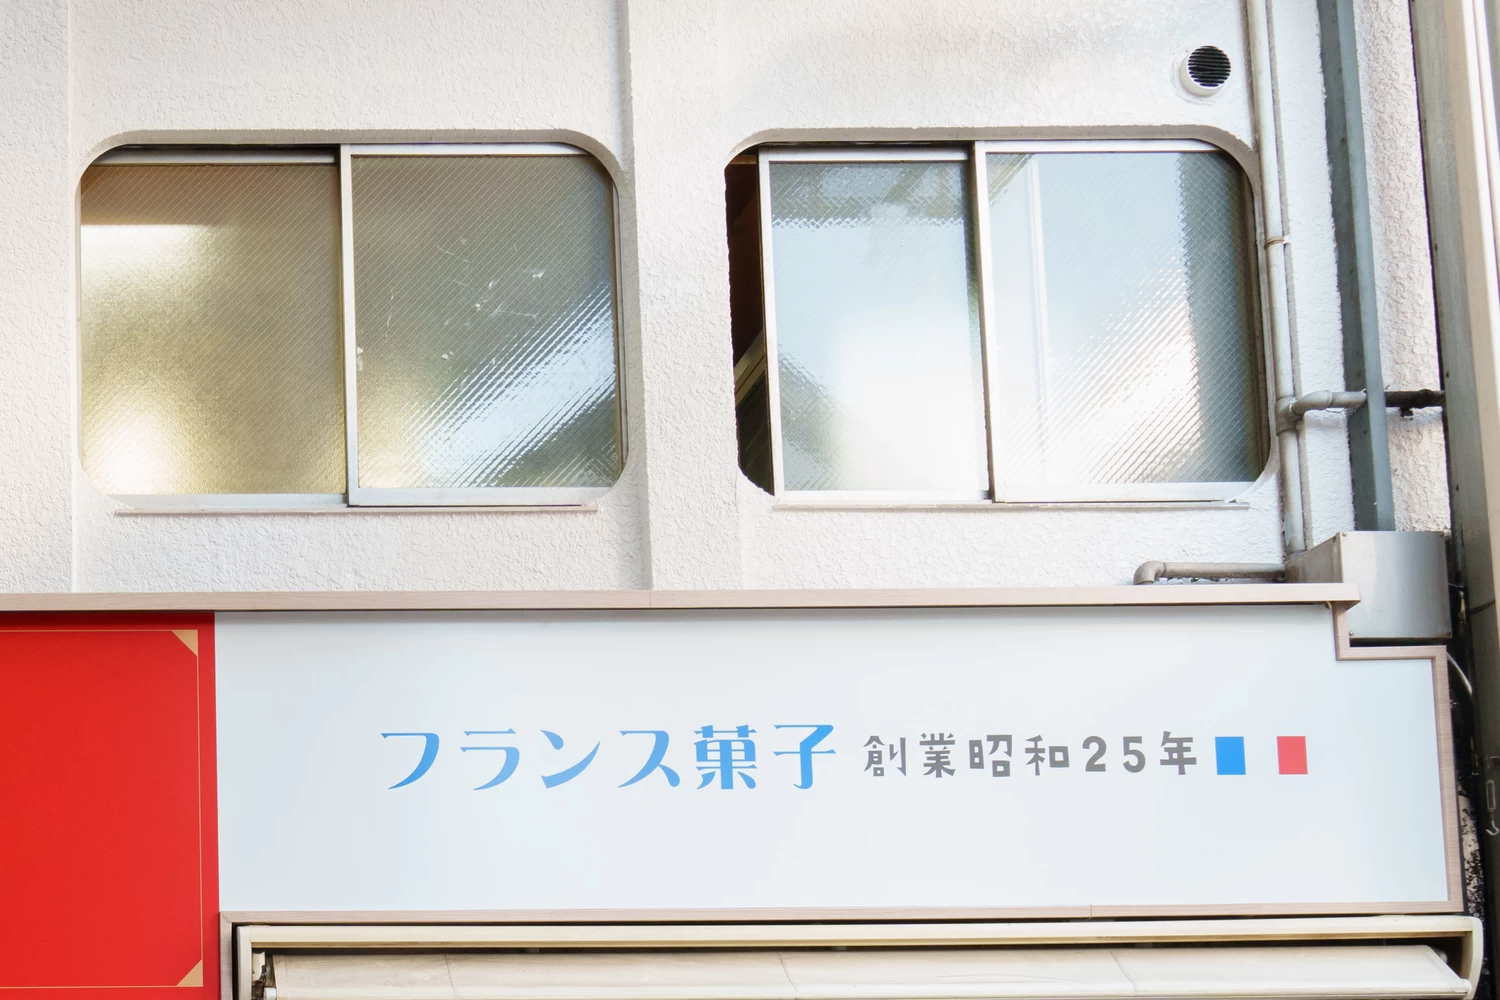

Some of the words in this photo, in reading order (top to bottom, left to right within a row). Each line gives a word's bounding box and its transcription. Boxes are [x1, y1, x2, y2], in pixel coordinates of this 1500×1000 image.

[381, 724, 837, 791] フランス菓子
[863, 730, 1198, 778] 創業昭和25年
